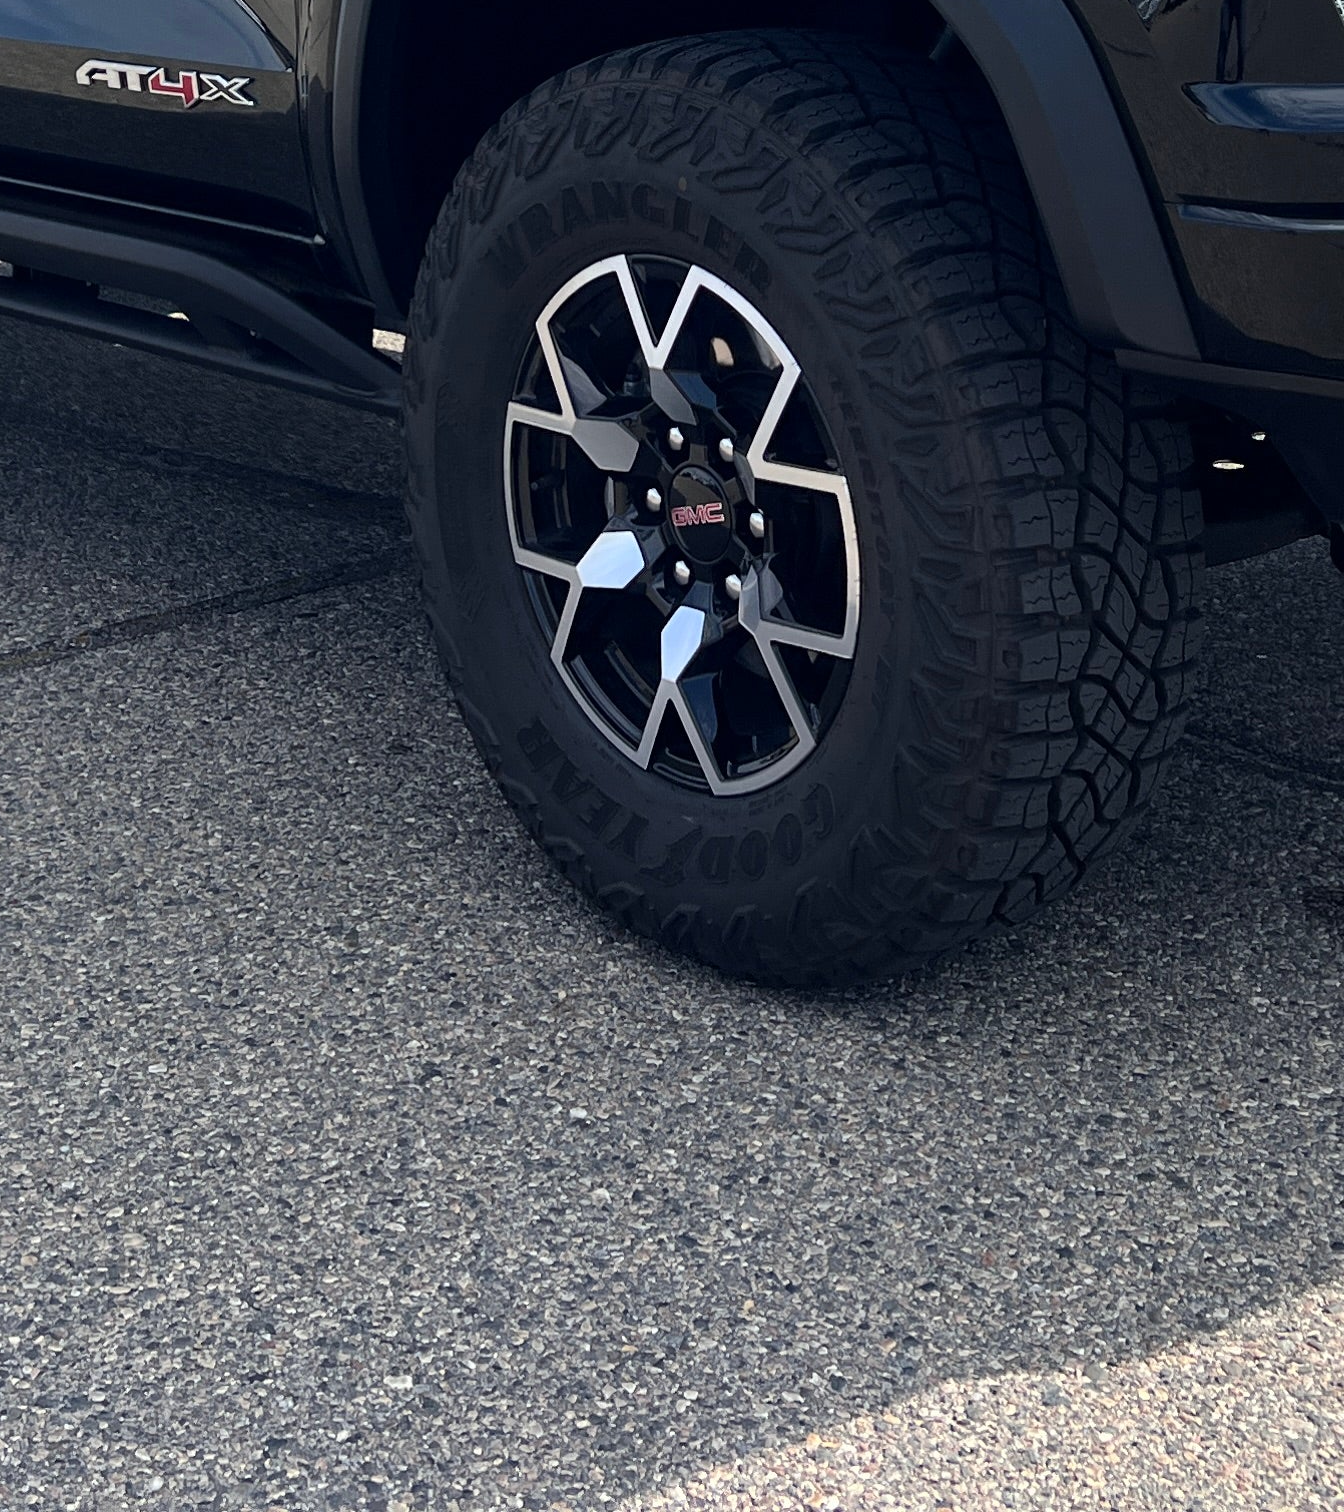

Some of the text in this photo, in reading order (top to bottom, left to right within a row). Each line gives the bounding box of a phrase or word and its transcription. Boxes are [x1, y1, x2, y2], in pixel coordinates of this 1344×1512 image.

[76, 59, 254, 108] AT4X
[484, 178, 772, 296] WRANGLER
[671, 502, 725, 527] GMC
[516, 716, 834, 887] GOODYEAR
